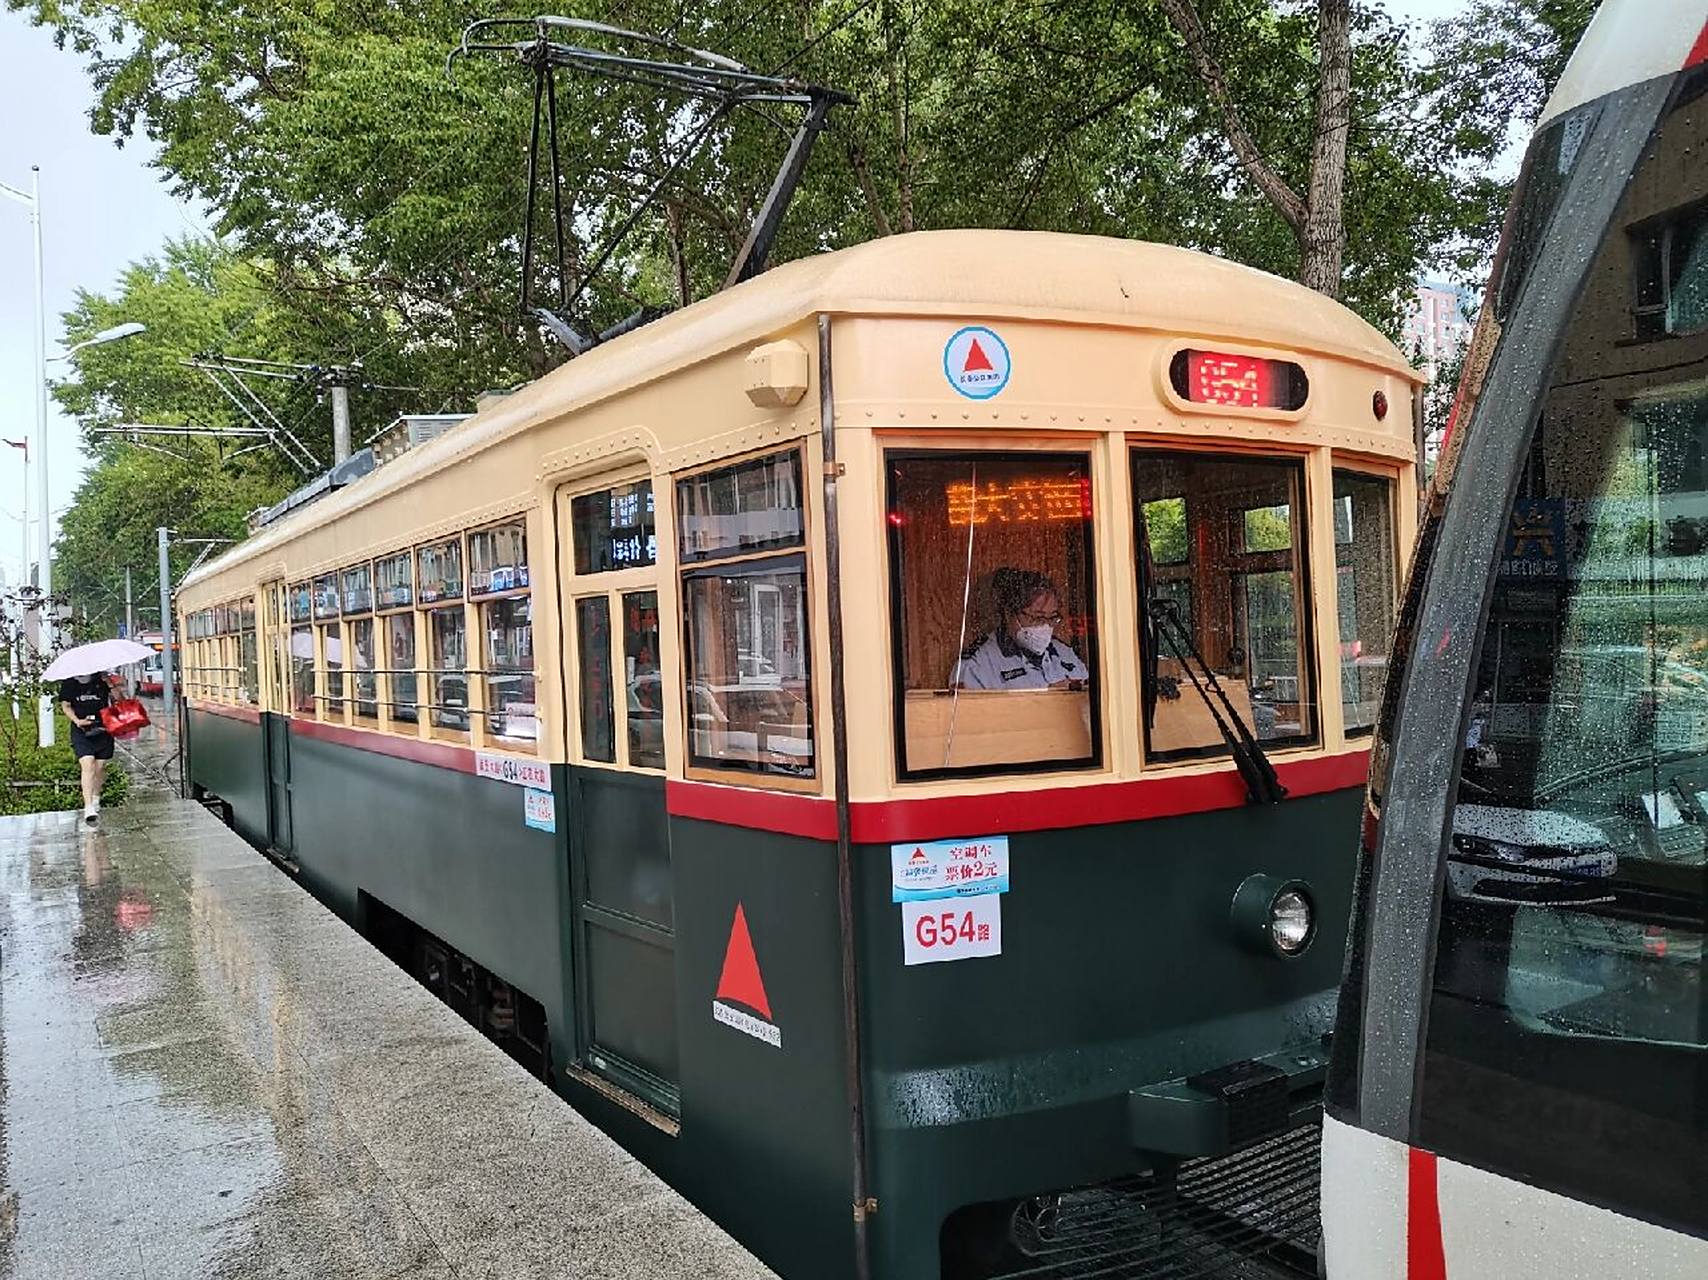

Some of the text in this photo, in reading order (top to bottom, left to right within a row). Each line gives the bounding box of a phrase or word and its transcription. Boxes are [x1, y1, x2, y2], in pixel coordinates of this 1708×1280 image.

[949, 844, 992, 861] 空调车
[944, 861, 998, 882] 票价2元
